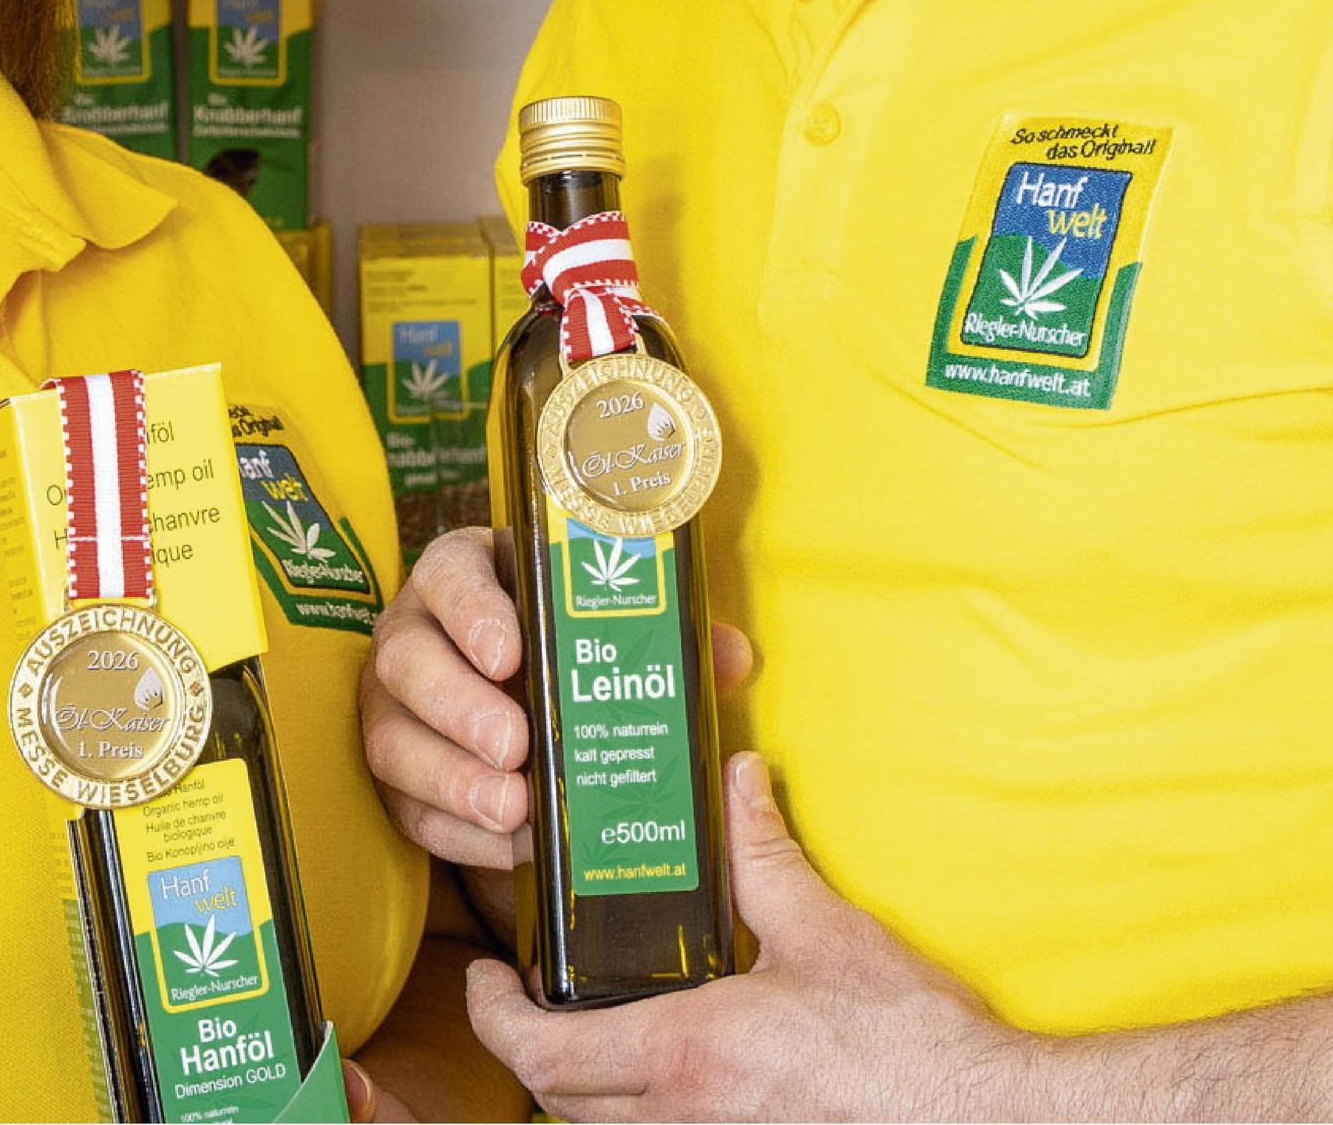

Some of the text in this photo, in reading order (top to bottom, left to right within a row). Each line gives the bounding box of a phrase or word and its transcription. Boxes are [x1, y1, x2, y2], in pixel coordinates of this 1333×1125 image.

[1010, 122, 1119, 146] So schmeckt
[1045, 142, 1079, 161] das
[1015, 171, 1089, 210] Hanf
[1046, 202, 1108, 241] welt
[963, 311, 1088, 348] Riegler-Nurscher
[944, 362, 1092, 398] www.hanfwelt.at
[596, 392, 646, 420] 2026
[192, 458, 214, 482] oil
[613, 471, 672, 497] 1. Preis
[575, 594, 658, 610] Riegler-Nurscher
[26, 608, 196, 676] AUSZEICHNUNG
[575, 638, 618, 665] Bio
[87, 650, 139, 671] 2026
[570, 664, 677, 703] Leinöl
[573, 721, 670, 740] 100% naturrein
[16, 704, 205, 804] MESSE WIESELBURG
[78, 741, 144, 760] 1. Preis
[573, 745, 656, 766] kalt gepresst
[575, 768, 658, 789] nicht gefiltert
[143, 793, 224, 818] Organic hemp oil
[146, 810, 227, 834] Huile de chanvre
[163, 825, 213, 843] biologique
[146, 850, 164, 863] Bio
[160, 868, 211, 901] Hanf
[583, 861, 687, 882] www.hanfwelt.at
[194, 884, 239, 914] welt
[171, 973, 259, 1002] Riegler-Nurscher
[198, 1016, 238, 1044] Bio
[180, 1030, 275, 1077] Hanföl
[174, 1062, 287, 1100] Dimension GOLD
